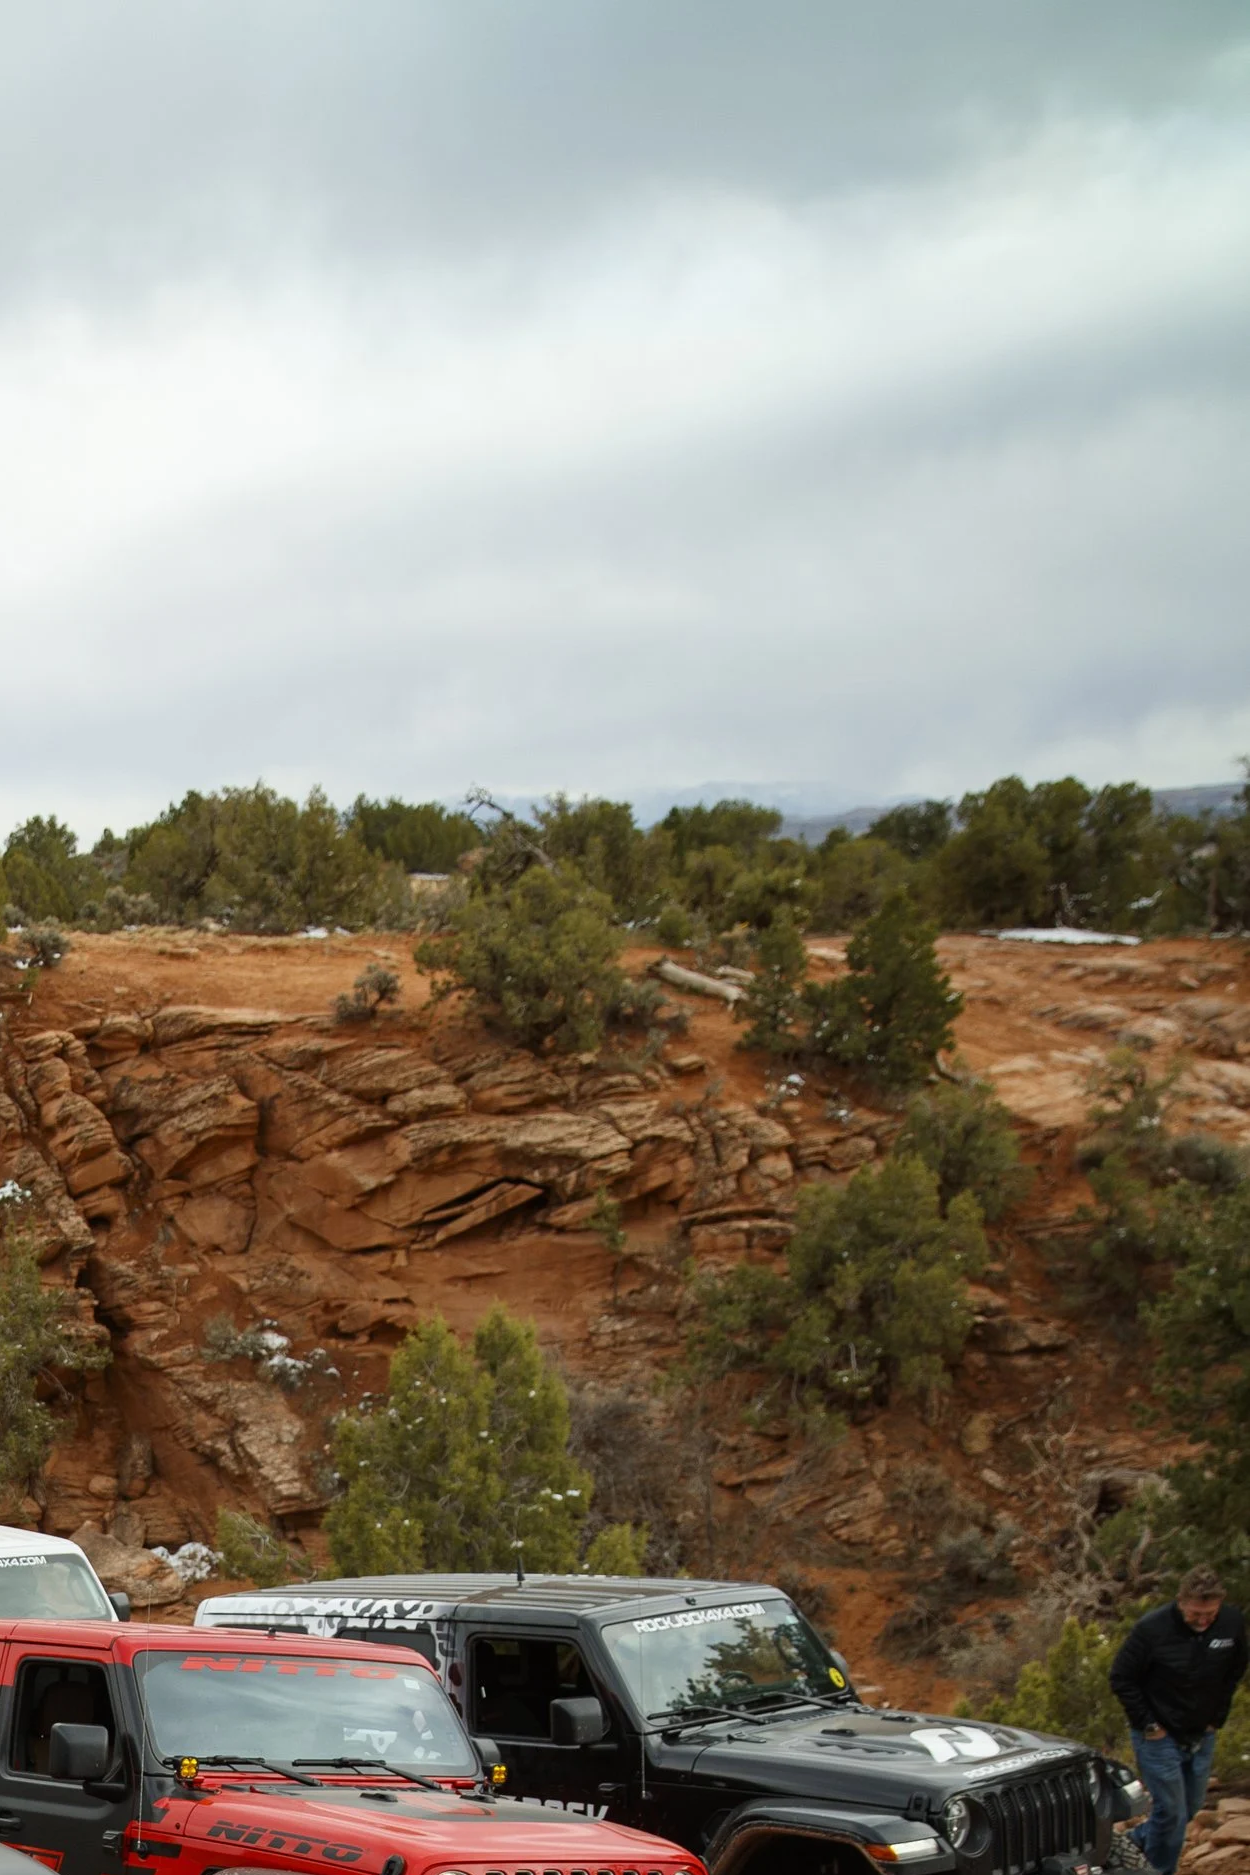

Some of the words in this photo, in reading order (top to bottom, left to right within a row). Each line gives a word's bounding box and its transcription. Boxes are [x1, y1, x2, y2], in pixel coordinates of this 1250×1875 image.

[632, 1602, 766, 1633] ROCKJOCK4X4.COM
[180, 1656, 398, 1680] NITTO
[206, 1820, 364, 1863] NITTO
